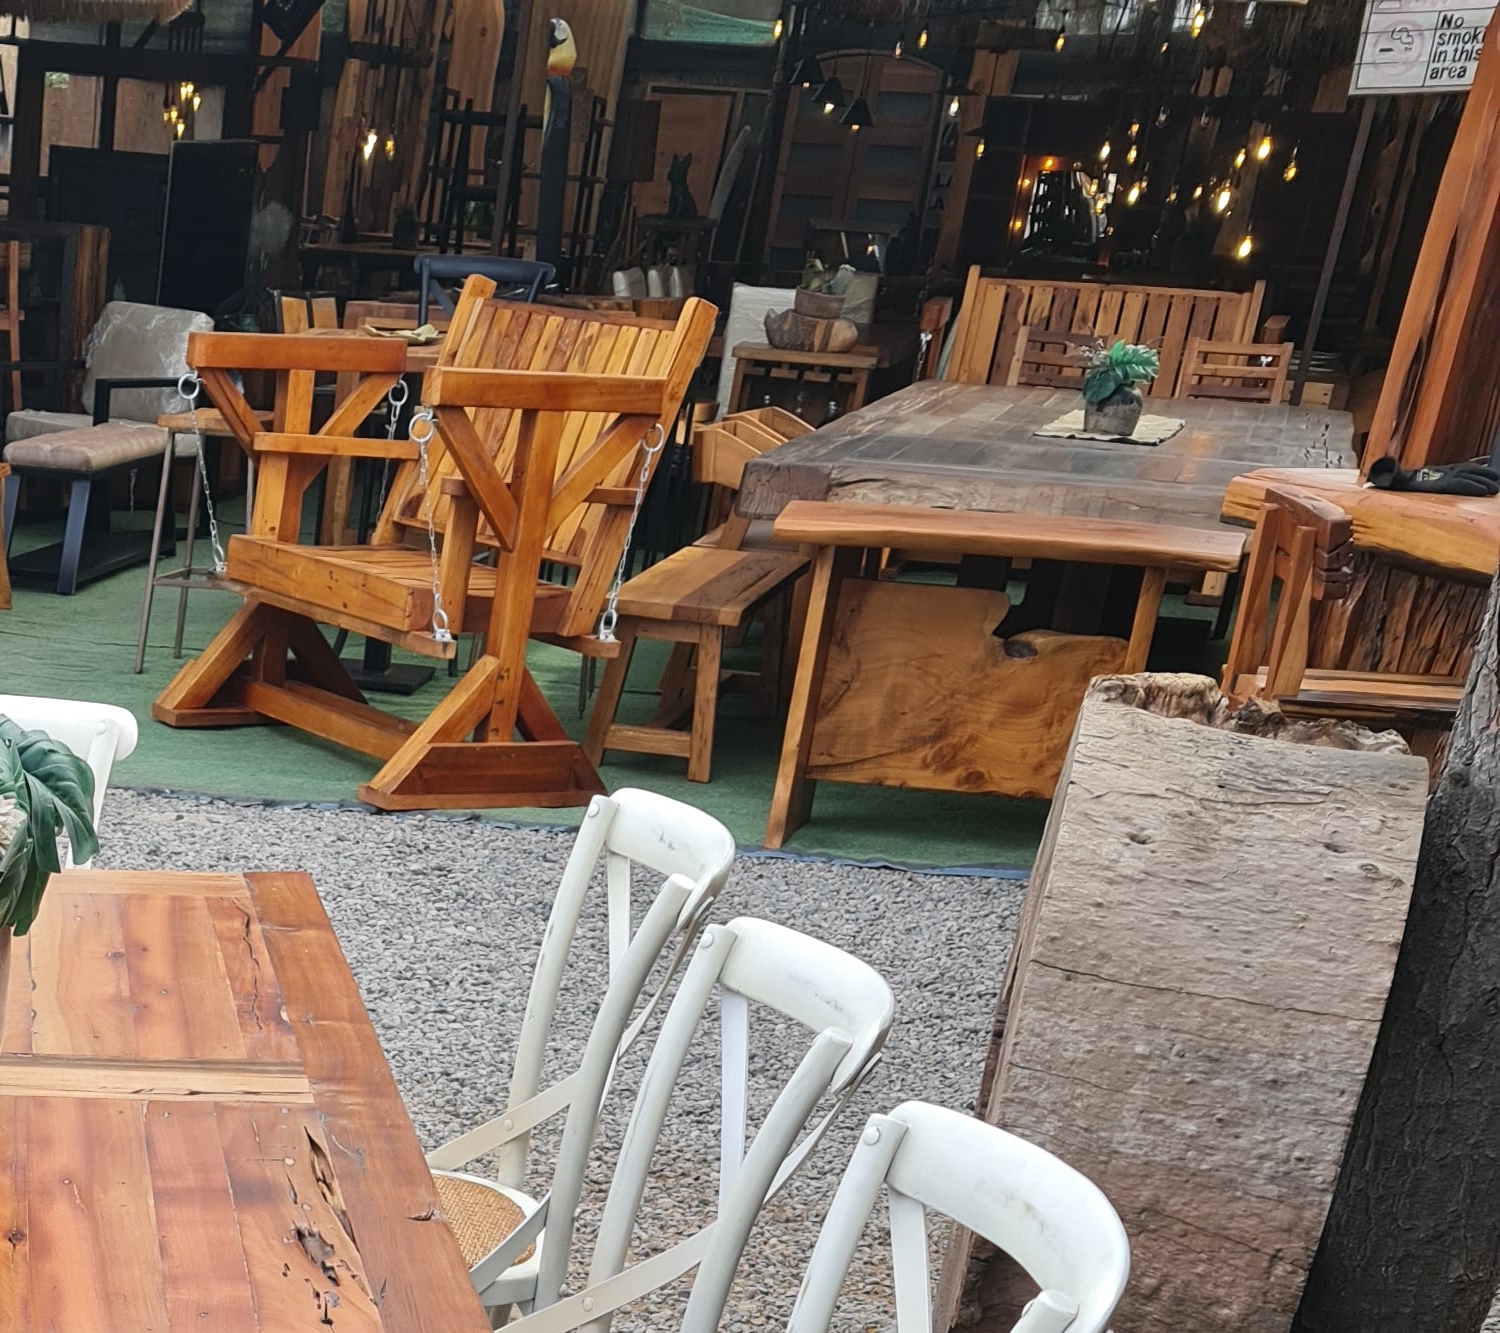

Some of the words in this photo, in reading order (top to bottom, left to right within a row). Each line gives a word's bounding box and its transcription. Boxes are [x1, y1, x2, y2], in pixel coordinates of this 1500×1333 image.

[1440, 13, 1465, 29] No
[1437, 27, 1487, 46] smoki
[1432, 46, 1448, 63] in
[1452, 45, 1482, 63] this
[1429, 65, 1467, 80] area
